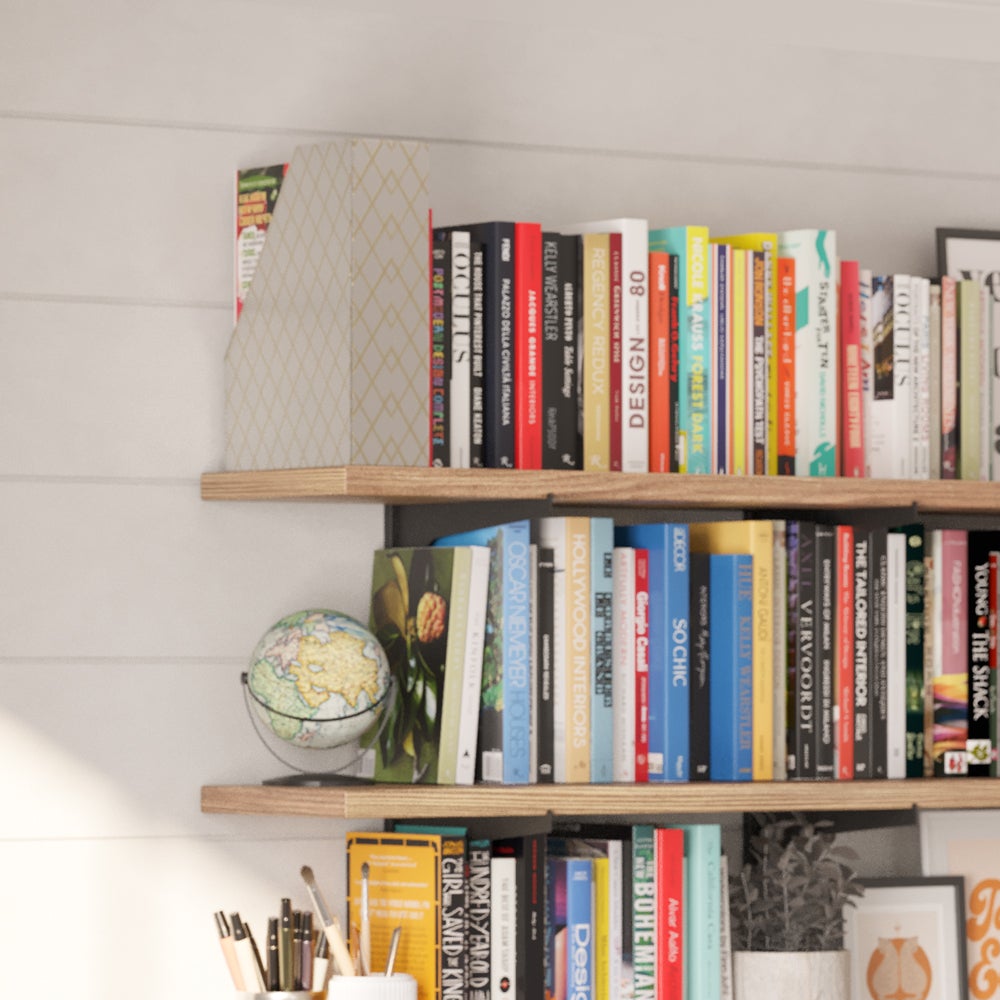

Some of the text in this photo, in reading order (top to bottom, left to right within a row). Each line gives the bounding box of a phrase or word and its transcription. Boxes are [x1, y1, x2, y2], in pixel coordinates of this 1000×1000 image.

[501, 278, 511, 319] PALAZZO
[543, 241, 559, 341] KELLY WEARSTLER
[591, 248, 606, 396] REGENCY REDUX
[629, 271, 645, 297] 80
[501, 319, 511, 349] DELLA
[692, 236, 704, 456] NICOLE KRAUSS FOREST DARK
[629, 337, 645, 429] DESIGN
[508, 541, 527, 603] OSCAR
[974, 562, 990, 615] YOUNG
[508, 605, 527, 688] NIEMEYER
[572, 534, 587, 749] HOLLYWOOD INTERIORS
[672, 618, 687, 687] SO CHIC
[739, 615, 753, 658] KELLY
[800, 599, 813, 734] VERVOORDT
[854, 541, 868, 707] THE TAILORED INTERIOR
[739, 665, 753, 751] WEARSTLER
[971, 629, 990, 721] THE SHACK
[442, 858, 465, 957] GIRL SAVED
